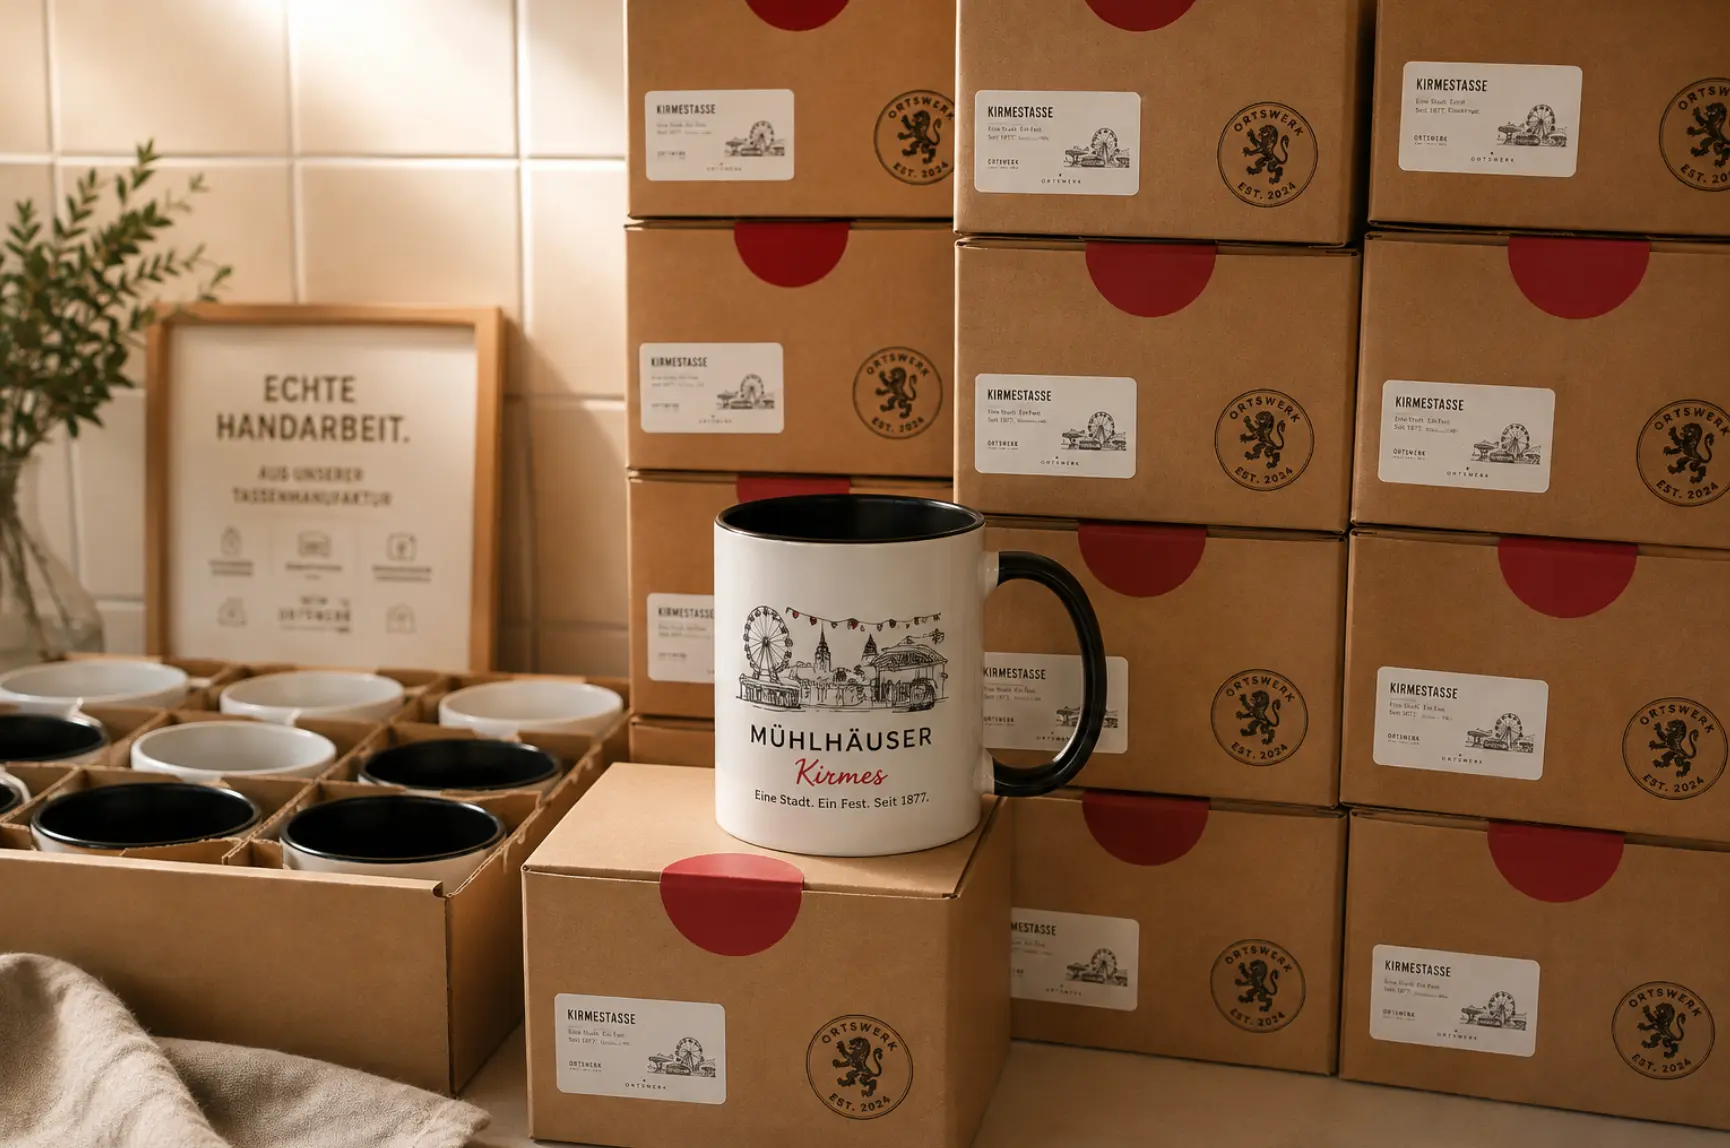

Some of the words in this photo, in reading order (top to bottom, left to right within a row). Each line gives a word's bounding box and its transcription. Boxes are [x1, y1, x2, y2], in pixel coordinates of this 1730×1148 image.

[1416, 78, 1488, 92] KIRMESTASSE
[1678, 86, 1730, 110] ORTSW
[656, 103, 716, 115] KIRMESTASSE
[987, 106, 1054, 119] KIRMESTASSE
[1234, 109, 1303, 136] ORTSWERK
[1680, 163, 1707, 183] EST.
[1237, 181, 1263, 200] EST.
[1267, 182, 1296, 200] 2024
[263, 374, 356, 404] ECHTE
[987, 389, 1052, 402] KIRMESTASSE
[1229, 396, 1300, 423] ORTSWERK
[1395, 396, 1464, 411] KIRMESTASSE
[216, 413, 411, 443] HANDARBEIT.
[1654, 407, 1730, 436] ORTSWERK
[1235, 466, 1260, 484] EST.
[1264, 466, 1293, 484] 2024
[1656, 479, 1682, 499] EST.
[1687, 481, 1718, 499] 2024
[983, 667, 1046, 680] KIRMESTASSE
[1226, 676, 1295, 702] ORTSWERK
[1389, 682, 1459, 700] KIRMESTASSE
[1640, 704, 1715, 733] ORTSWERK
[750, 723, 932, 752] MÜHLHÄUSER
[1231, 741, 1256, 759] EST.
[1260, 743, 1288, 760] 2024
[794, 757, 888, 787] Kirmes
[1643, 773, 1668, 792] EST.
[1674, 776, 1704, 793] 2024
[755, 789, 777, 803] Eine
[780, 793, 814, 808] Stadt.
[818, 797, 837, 809] Ein
[841, 798, 870, 809] Fest.
[874, 796, 898, 808] Seit
[901, 791, 930, 806] 1877.
[1225, 945, 1292, 972] ORTSWERK
[1385, 960, 1451, 977] KIRMESTASSE
[1629, 988, 1702, 1017] ORTSWERK
[567, 1009, 636, 1025] KIRMESTASSE
[822, 1022, 898, 1052] ORTSWERK
[1662, 1058, 1691, 1073] 2024
[829, 1093, 855, 1112] EST.
[861, 1095, 891, 1112] 2024
